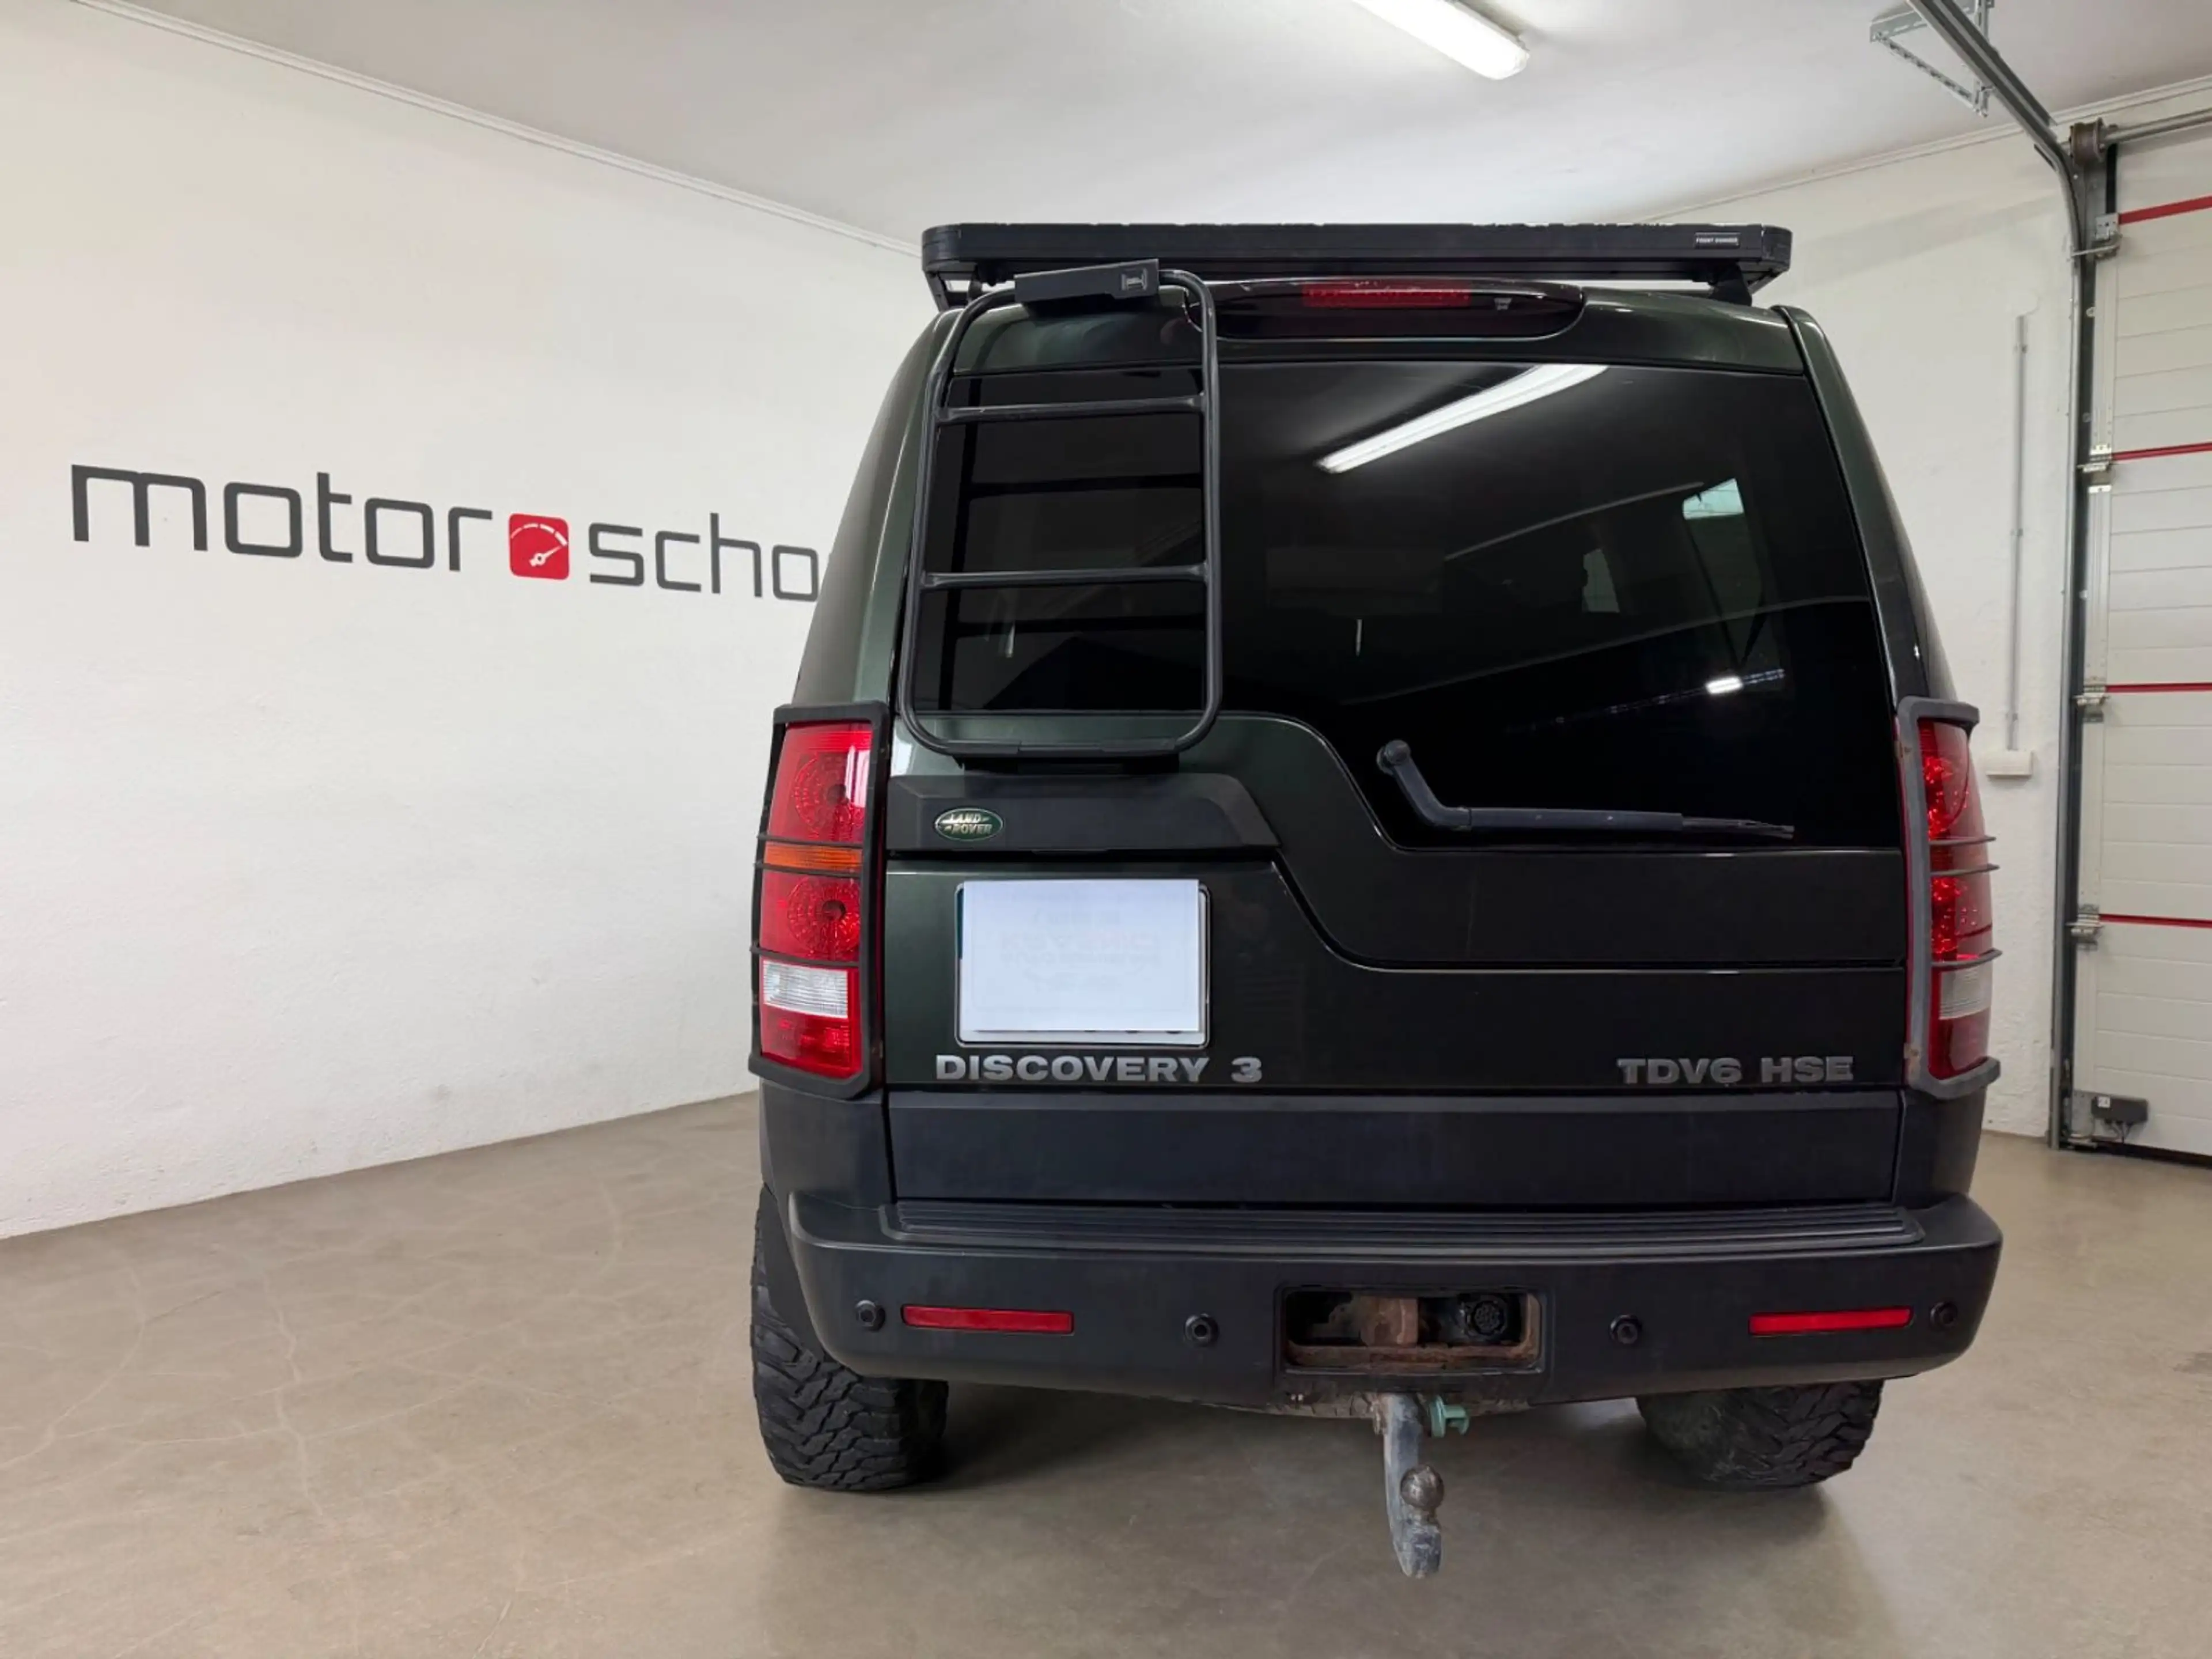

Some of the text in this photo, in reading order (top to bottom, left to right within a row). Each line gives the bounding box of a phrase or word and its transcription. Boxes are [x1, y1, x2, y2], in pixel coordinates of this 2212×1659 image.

[71, 464, 819, 603] motor scho
[950, 813, 982, 823] LAND
[951, 824, 993, 835] ROVER
[935, 1054, 1262, 1083] DISCOVERY 3
[1617, 1056, 1854, 1084] TDV6 HSE
